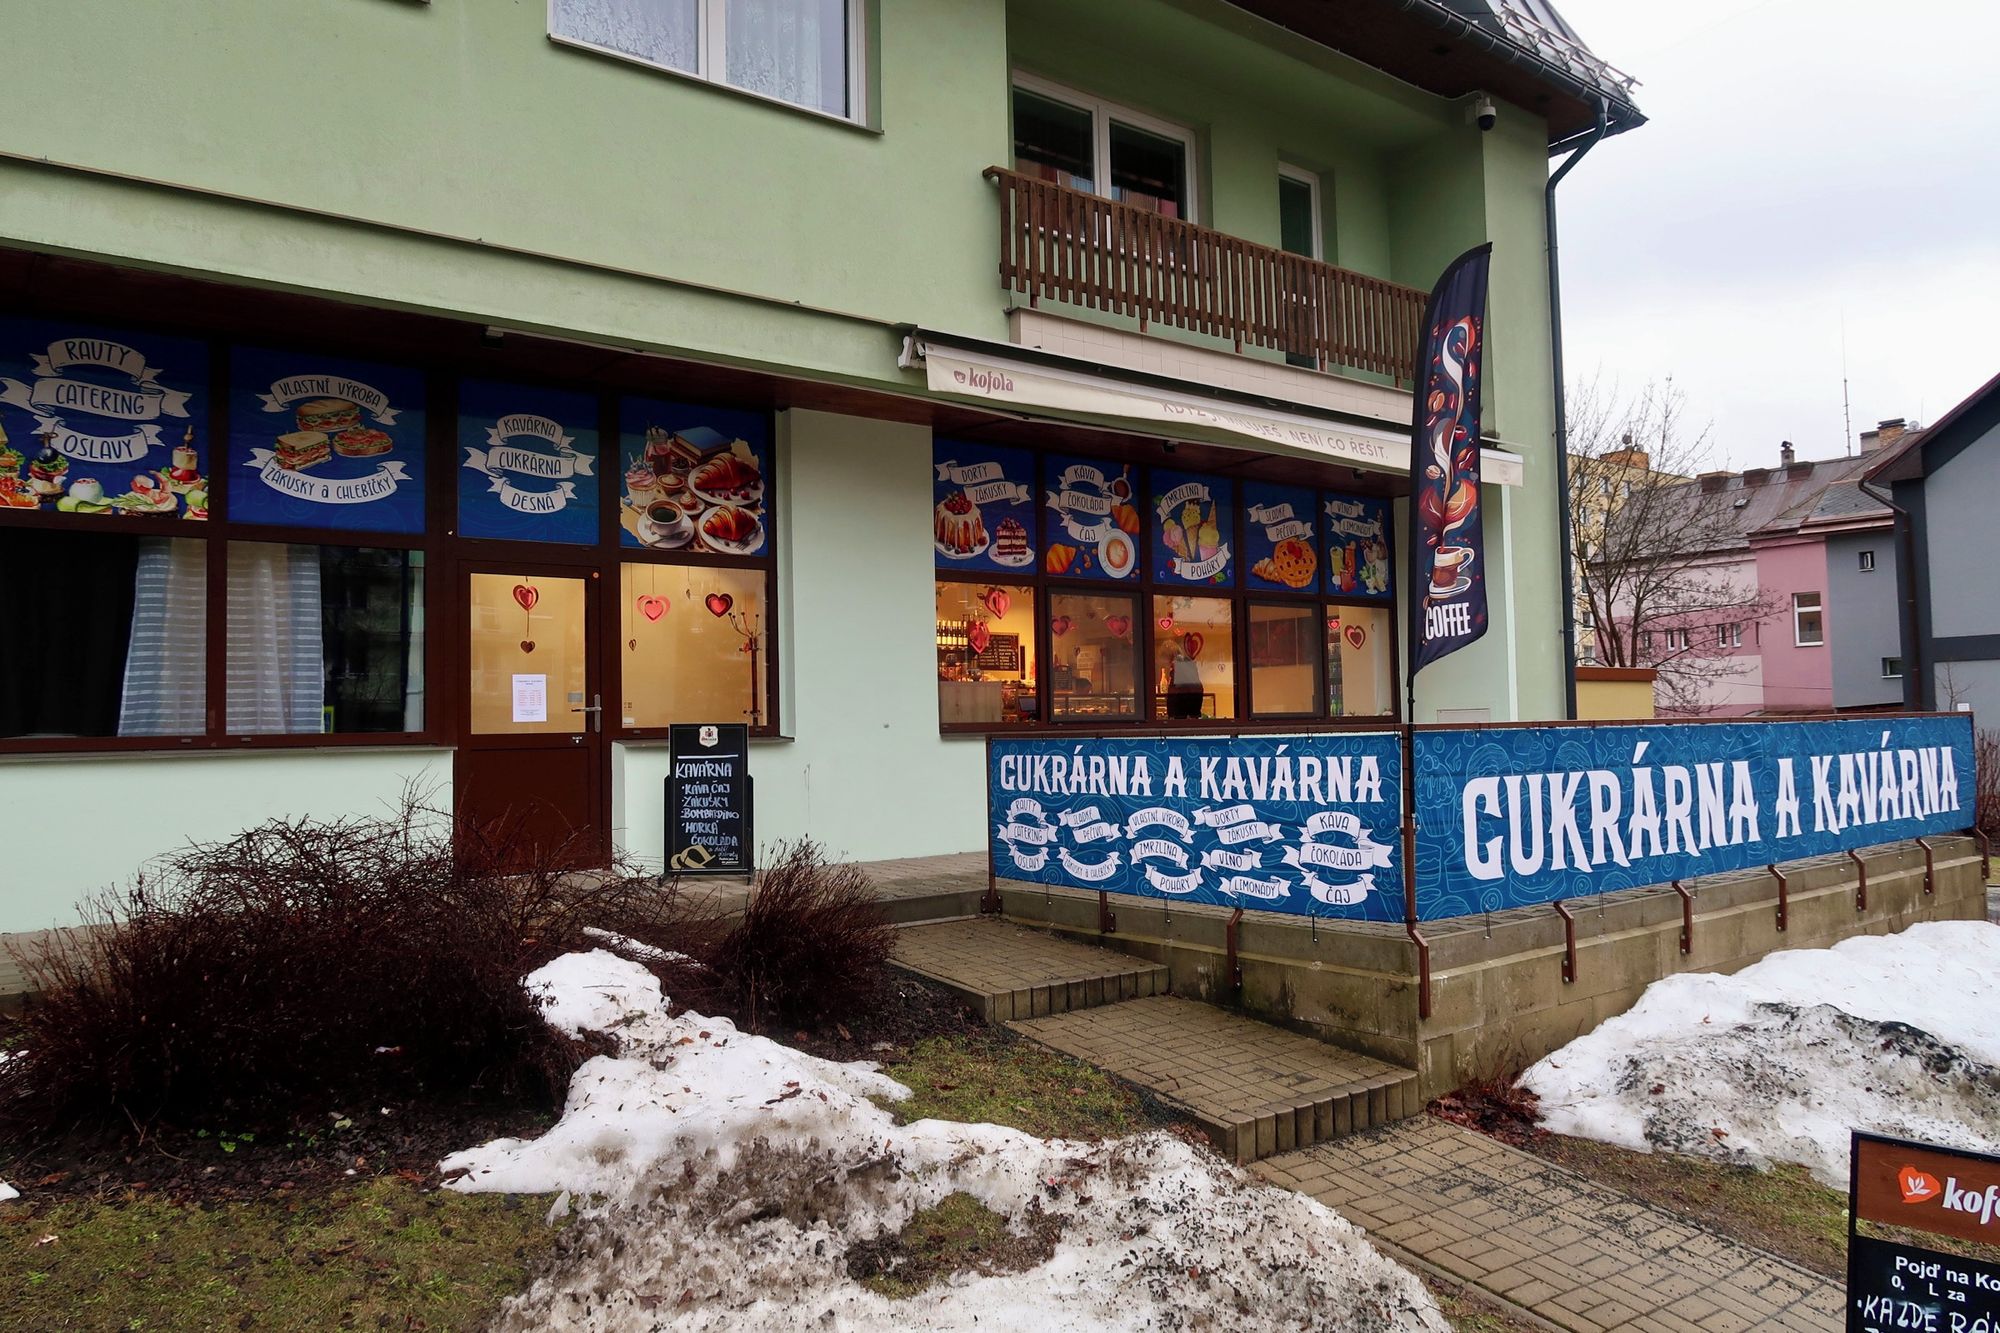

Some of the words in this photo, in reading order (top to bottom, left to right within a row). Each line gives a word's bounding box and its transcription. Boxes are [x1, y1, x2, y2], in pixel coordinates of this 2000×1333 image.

[64, 340, 131, 366] RAUTY
[969, 367, 1014, 394] kofola
[55, 383, 145, 415] CATERING
[278, 377, 331, 397] VLASTNÍ
[337, 380, 381, 408] VÝROBA
[503, 416, 556, 439] KAVÁRNA
[63, 434, 133, 460] OSLAVY
[1289, 430, 1324, 447] NENÍ
[1327, 436, 1346, 452] CO
[499, 450, 562, 476] CUKRÁRNA
[961, 464, 988, 483] DORTY
[1073, 465, 1096, 482] KÁVA
[264, 465, 315, 497] ZÁKUSKY
[321, 484, 329, 499] a
[336, 475, 392, 500] CHLEBÍČKY
[975, 482, 1007, 503] ZÁKUSKY
[511, 492, 556, 512] DESNÁ
[1067, 491, 1104, 512] ČOKOLÁDA
[1165, 484, 1200, 509] ZMRZLINA
[1079, 526, 1096, 542] ČAJ
[1190, 560, 1221, 578] POHÁRY
[1425, 602, 1471, 640] COFFEE
[675, 761, 733, 779] KAVÁRNA
[1001, 744, 1153, 798] CUKRÁRNA
[1164, 755, 1188, 798] A
[1199, 744, 1384, 805] KAVÁRNA
[684, 781, 710, 795] KÁVA
[711, 780, 731, 793] ČAJ
[1015, 799, 1037, 818] RAUTY
[1463, 740, 1759, 880] CUKRÁRNA
[1775, 757, 1803, 839] A
[1811, 730, 1961, 836] KAVÁRNA
[1132, 810, 1160, 827] VLASTNÍ
[1161, 810, 1185, 831] VÝROBA
[1214, 808, 1240, 825] DORTY
[1319, 811, 1350, 831] KÁVA
[684, 820, 719, 835] HORKÁ
[1013, 825, 1043, 843] CATERING
[1227, 824, 1259, 843] ZÁKUSKY
[1138, 843, 1178, 859] ZMRZLINA
[1218, 853, 1243, 868] VÍNO
[1310, 845, 1362, 868] ČOKOLÁDA
[1017, 854, 1040, 870] OSLAVY
[1159, 876, 1191, 892] POHÁRY
[1233, 881, 1276, 898] LIMONÁDY
[1325, 885, 1352, 904] ČAJ
[1942, 1176, 2000, 1226] kof
[1895, 1255, 1941, 1281] Pojď
[1946, 1268, 1970, 1286] na
[1929, 1282, 1940, 1297] L
[1947, 1289, 1967, 1303] za
